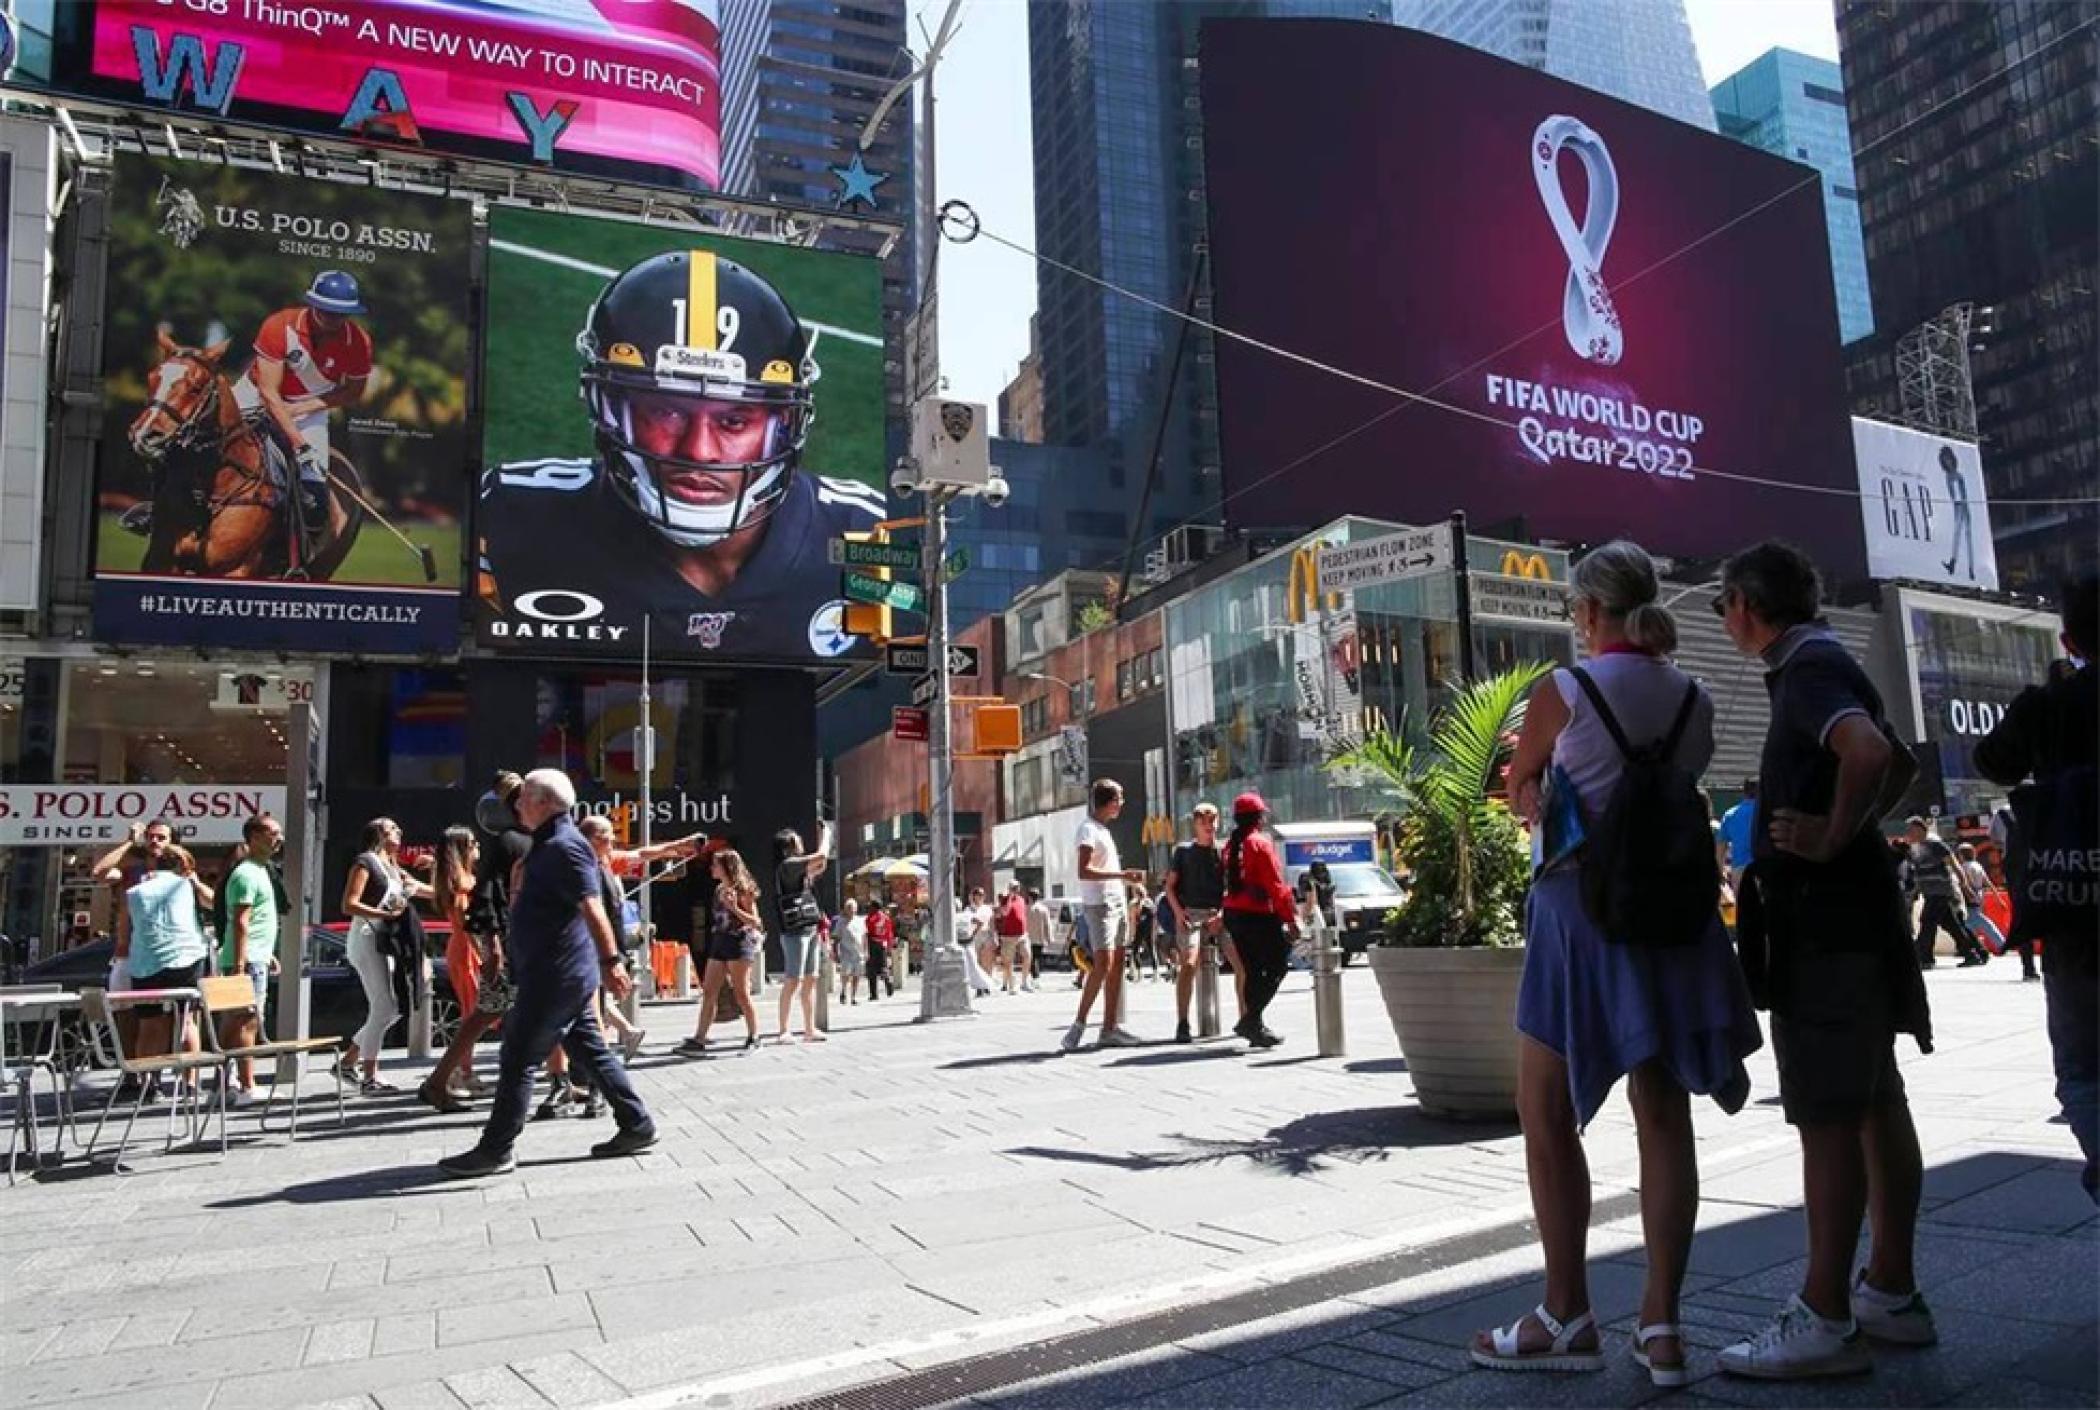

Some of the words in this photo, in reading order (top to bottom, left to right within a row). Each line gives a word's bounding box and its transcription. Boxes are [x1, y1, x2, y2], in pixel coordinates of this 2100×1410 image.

[357, 19, 380, 42] A
[388, 23, 462, 57] NEW
[468, 36, 532, 69] WAY
[539, 50, 575, 77] TO
[583, 58, 706, 106] INTERACT
[215, 205, 264, 231] U.S.
[271, 213, 350, 241] POLO
[356, 224, 437, 253] ASSN.
[278, 239, 331, 258] SINCE
[338, 247, 376, 263] 1890
[1486, 373, 1551, 415] FIFA
[1551, 386, 1651, 432] WORLD
[1655, 409, 1704, 443] CUP
[1881, 477, 1934, 542] GAP
[850, 545, 918, 570] Broadway
[1322, 545, 1378, 569] PEDESTRIAN
[1379, 540, 1406, 556] FLOW
[1409, 533, 1434, 551] ZONE
[1322, 570, 1345, 586] KEEP
[1348, 562, 1383, 581] MOVING
[139, 595, 421, 623] #LIVEAUTHENTICALLY
[491, 621, 628, 640] OAKLEY
[1951, 699, 1994, 735] OLD
[33, 792, 147, 819] POLO
[159, 792, 271, 819] ASSN.
[681, 792, 732, 823] hut
[23, 825, 113, 839] SINCE
